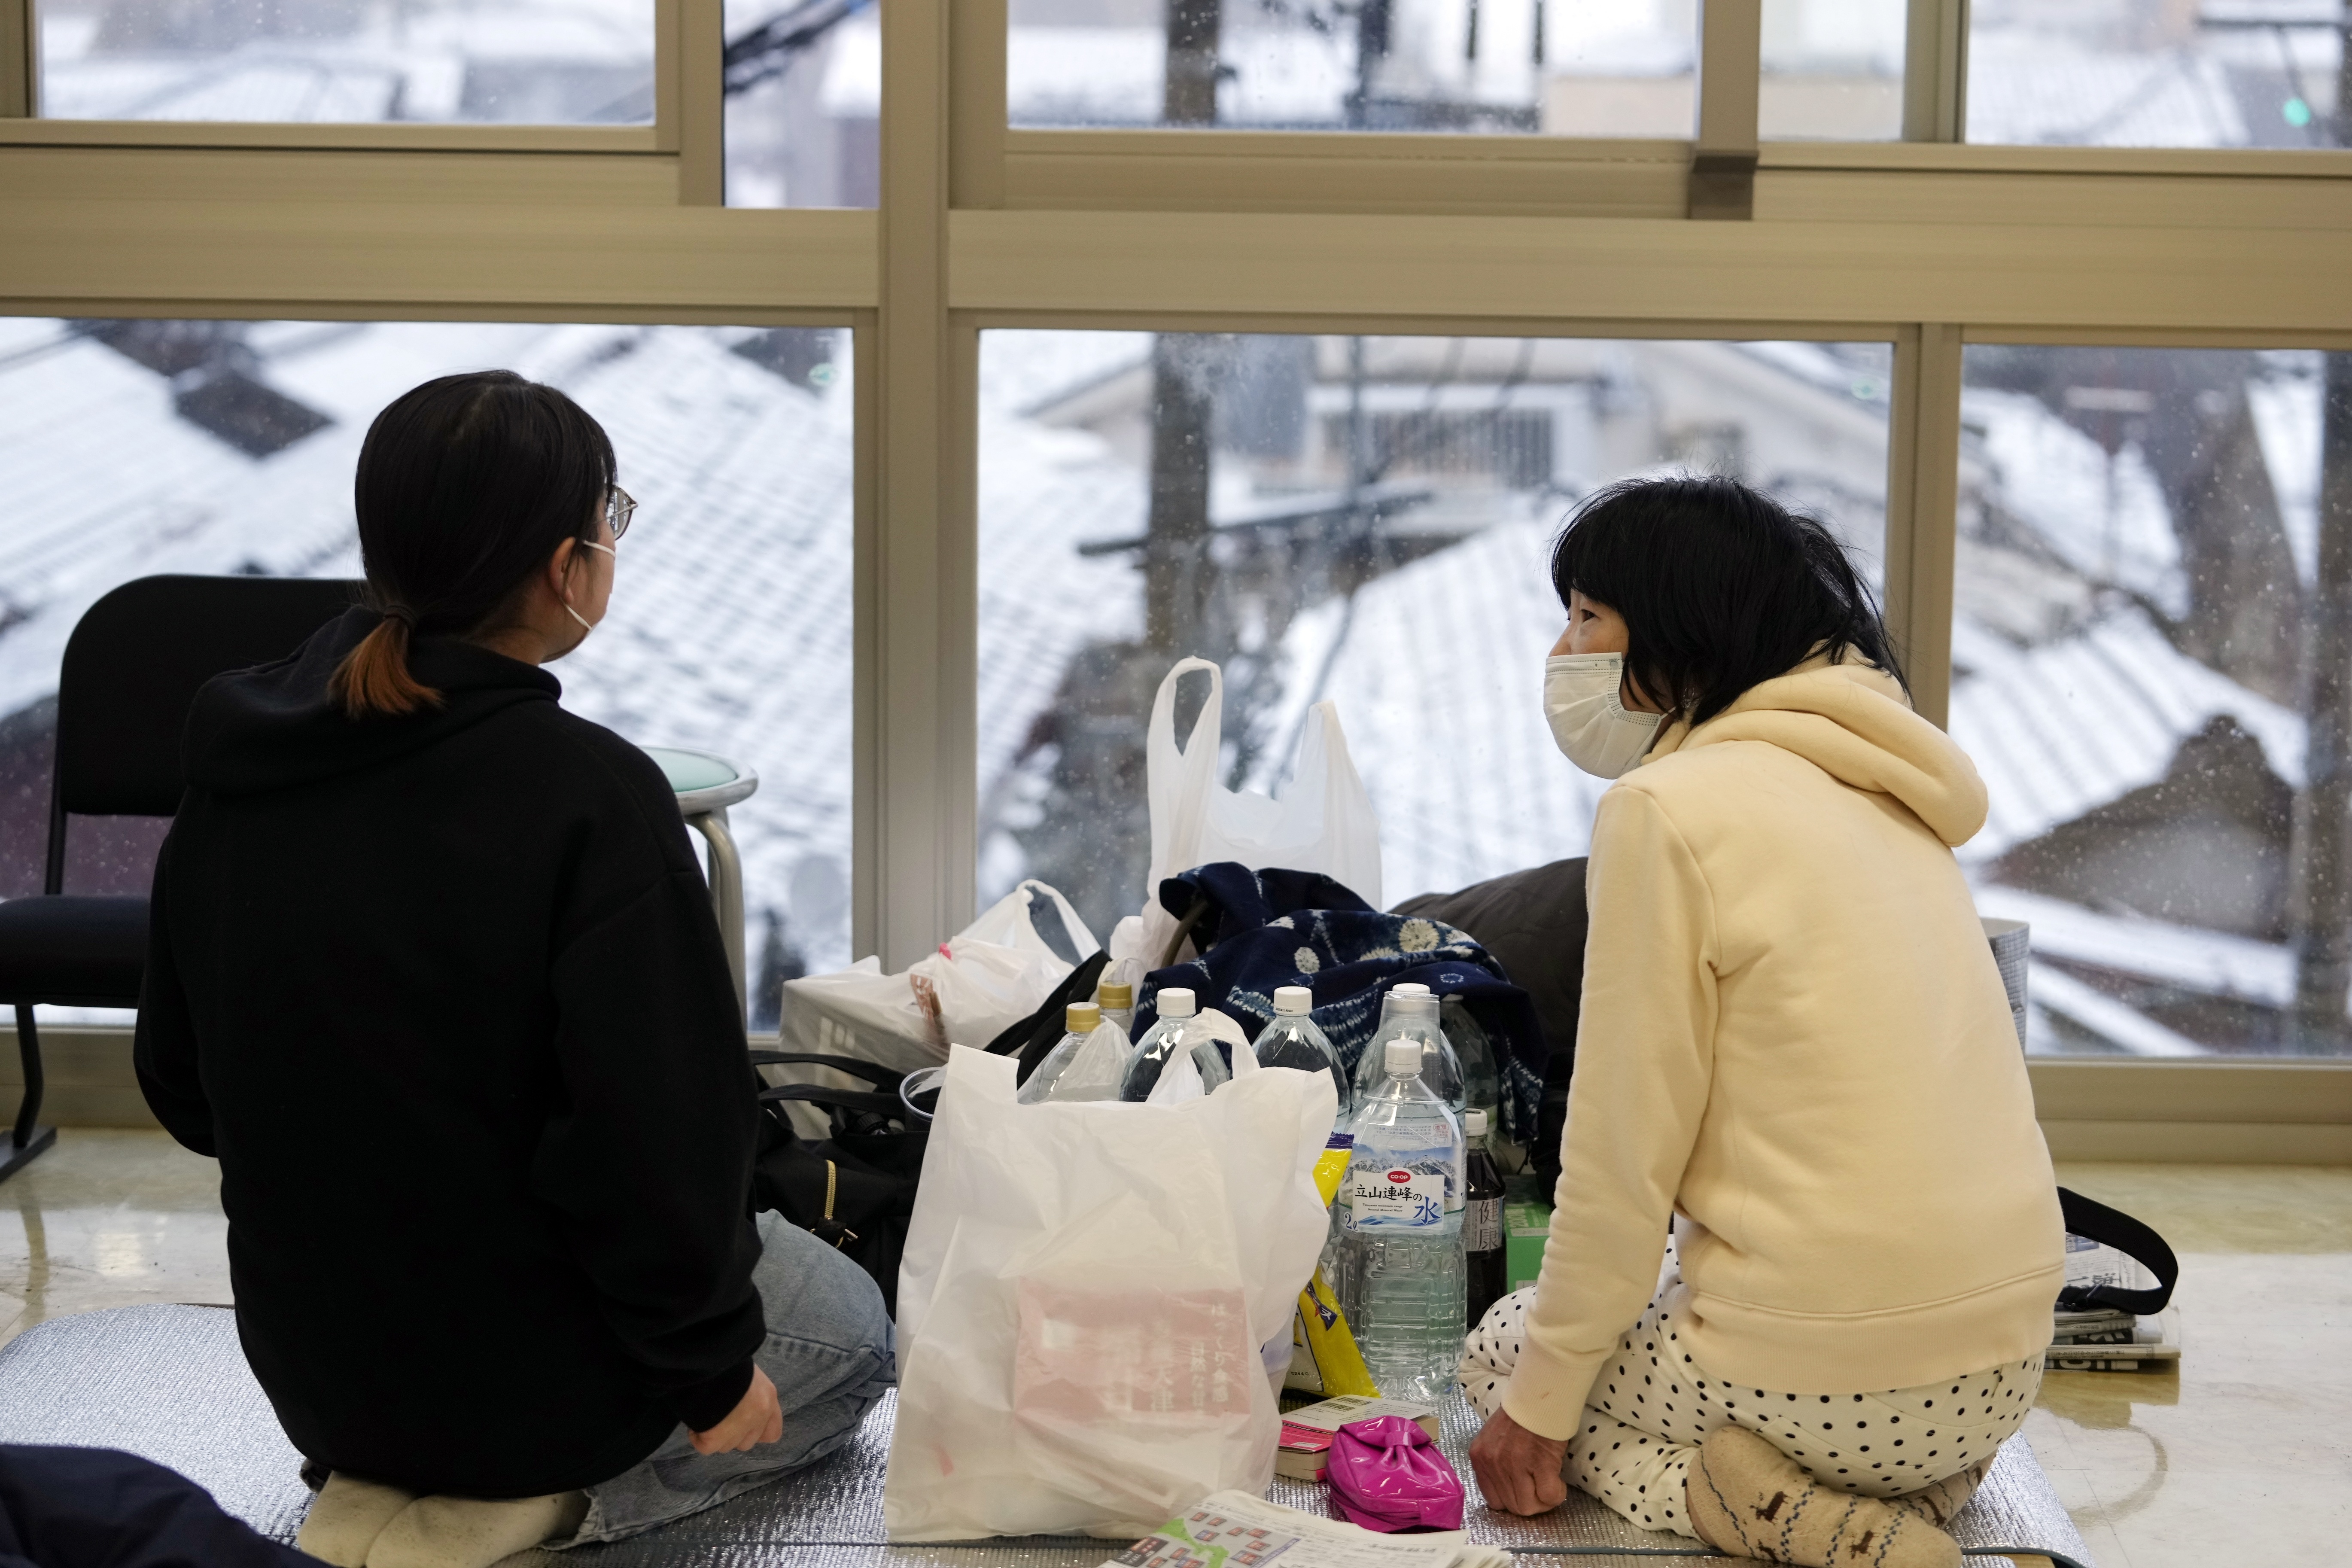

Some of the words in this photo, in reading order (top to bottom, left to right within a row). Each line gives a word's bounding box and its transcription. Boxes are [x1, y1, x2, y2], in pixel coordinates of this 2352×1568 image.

[1354, 1184, 1441, 1224] 立山連峰の水
[1478, 1199, 1498, 1250] 健康
